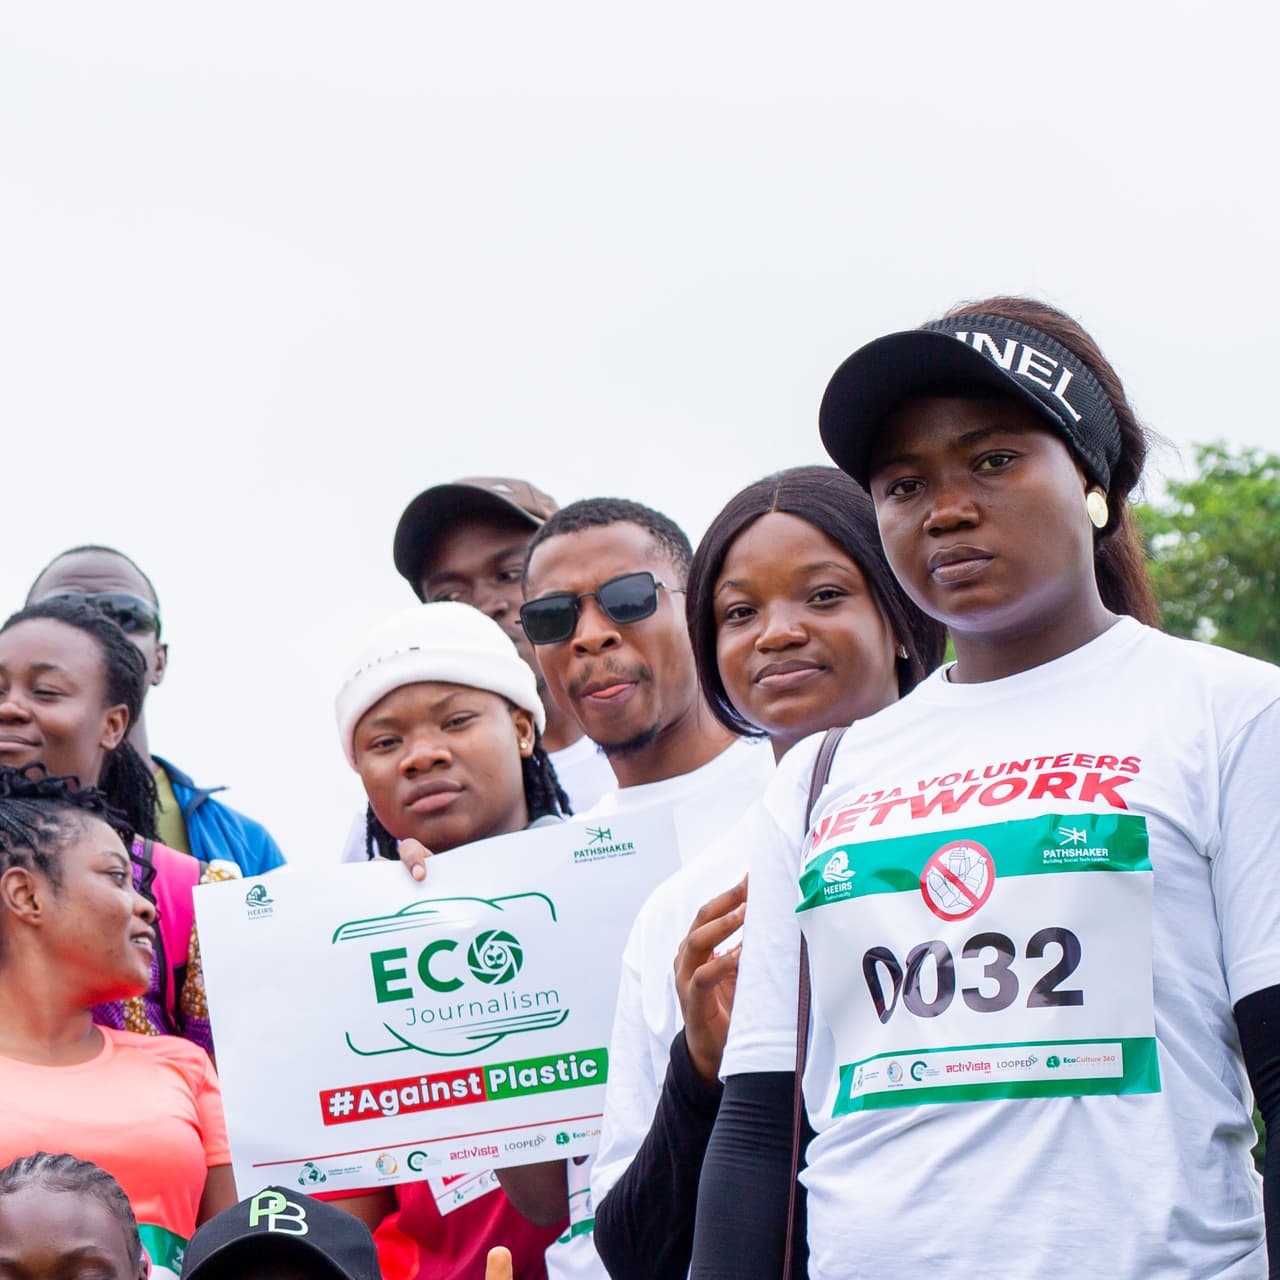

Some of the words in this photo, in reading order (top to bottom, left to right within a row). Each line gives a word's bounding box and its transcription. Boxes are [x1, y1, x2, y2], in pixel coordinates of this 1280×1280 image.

[916, 752, 1143, 791] VOLUNTEERS
[574, 842, 634, 859] PATHSHAKER
[1043, 848, 1109, 858] PATHSHAKER
[824, 880, 853, 897] HEEIRS
[370, 928, 524, 1004] ECO
[862, 926, 1085, 1025] 0032
[405, 988, 560, 1027] Journalism
[996, 1059, 1032, 1069] LOOPED
[1063, 1056, 1102, 1065] EcoCulture
[328, 1071, 482, 1118] #Against
[489, 1056, 599, 1093] Plastic
[504, 1137, 541, 1152] LOOPED
